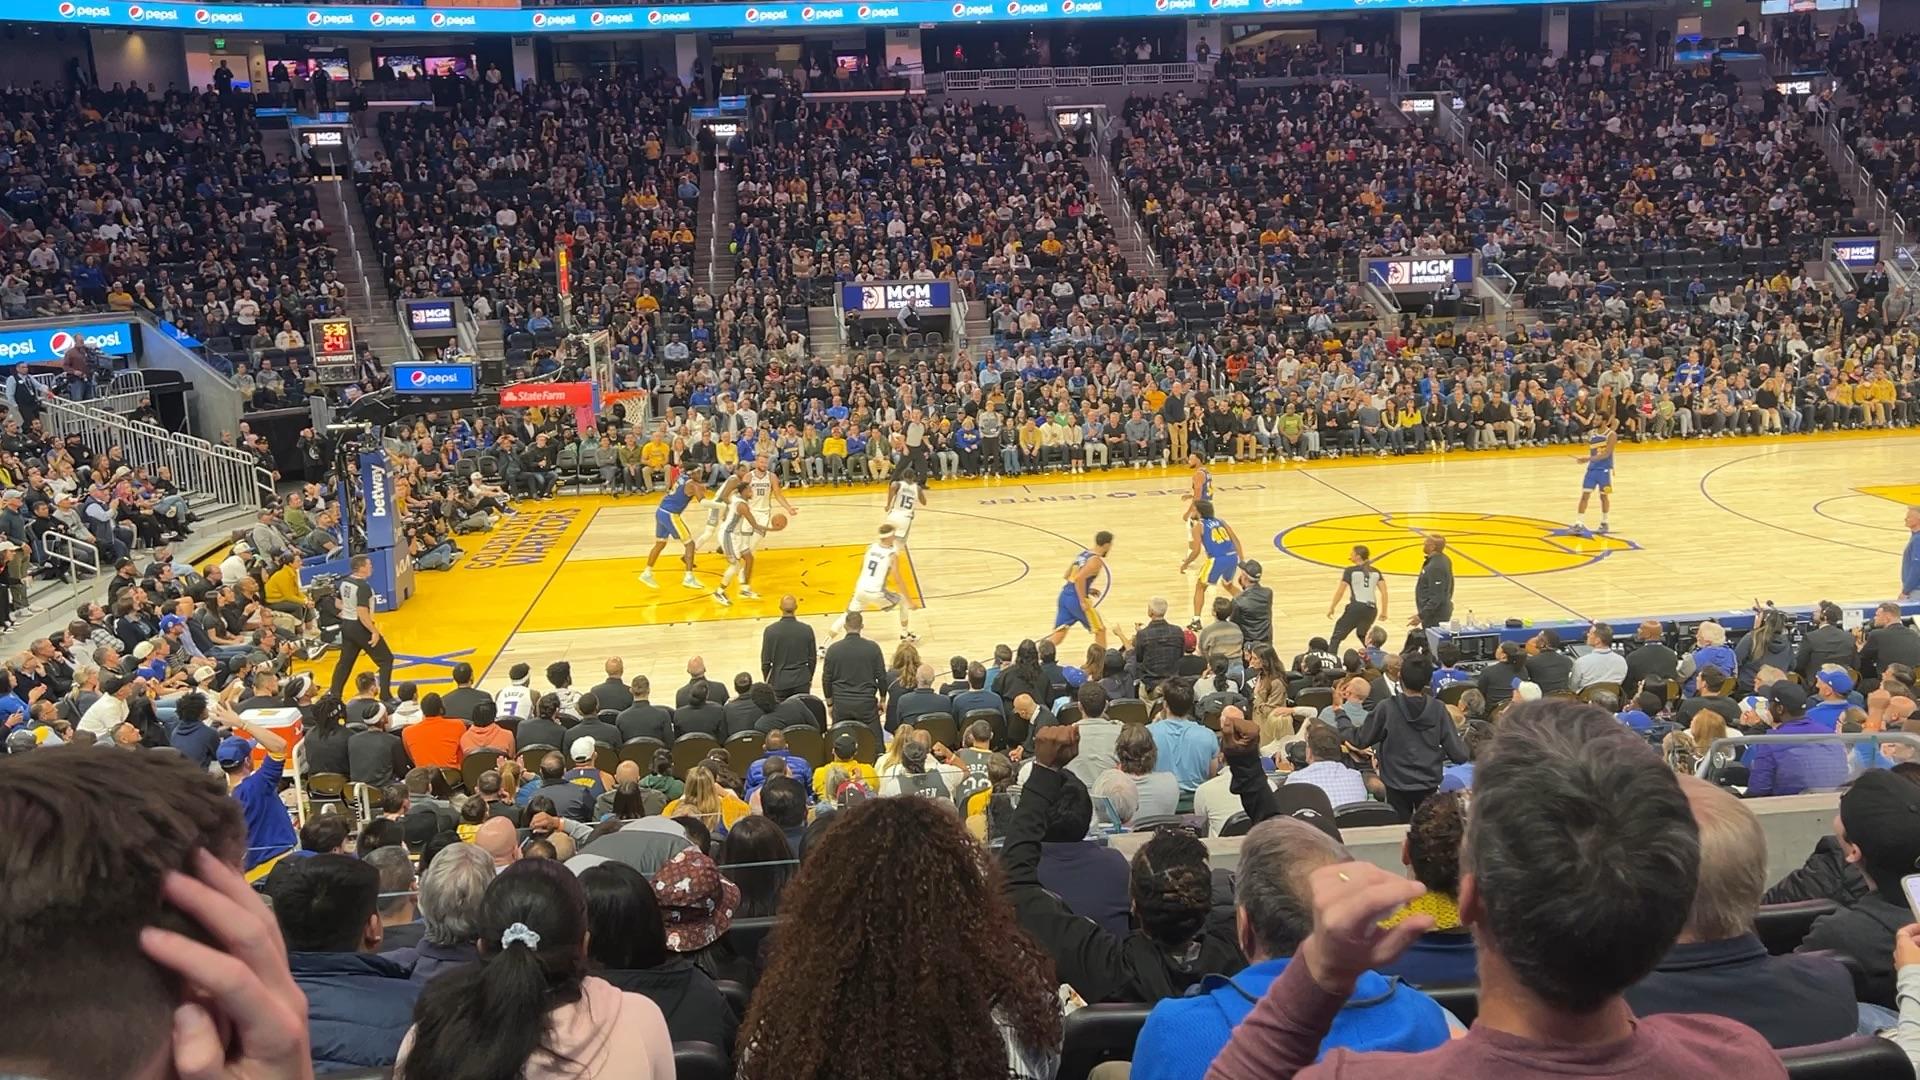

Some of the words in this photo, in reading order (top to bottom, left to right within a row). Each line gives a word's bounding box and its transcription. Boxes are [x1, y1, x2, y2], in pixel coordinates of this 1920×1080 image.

[965, 5, 993, 15] pepsi
[1020, 3, 1047, 14] pepsi
[1075, 2, 1102, 12] pepsi
[1169, 0, 1195, 11] pepsi
[76, 6, 110, 17] pepsi
[144, 10, 177, 20] pepsi
[759, 10, 787, 20] pepsi
[815, 8, 843, 20] pepsi
[871, 7, 899, 18] pepsi
[210, 13, 243, 24] pepsi
[322, 14, 353, 25] pepsi
[385, 15, 416, 26] pepsi
[445, 16, 475, 26] pepsi
[546, 15, 576, 26] pepsi
[604, 14, 633, 24] pepsi
[661, 12, 690, 23] pepsi
[1412, 260, 1453, 274] MGM
[887, 284, 930, 299] MGM
[324, 336, 343, 351] 24
[428, 373, 458, 384] pepsi
[371, 464, 386, 517] betway
[900, 494, 914, 510] 15
[1211, 526, 1230, 544] 40
[868, 560, 878, 577] 9
